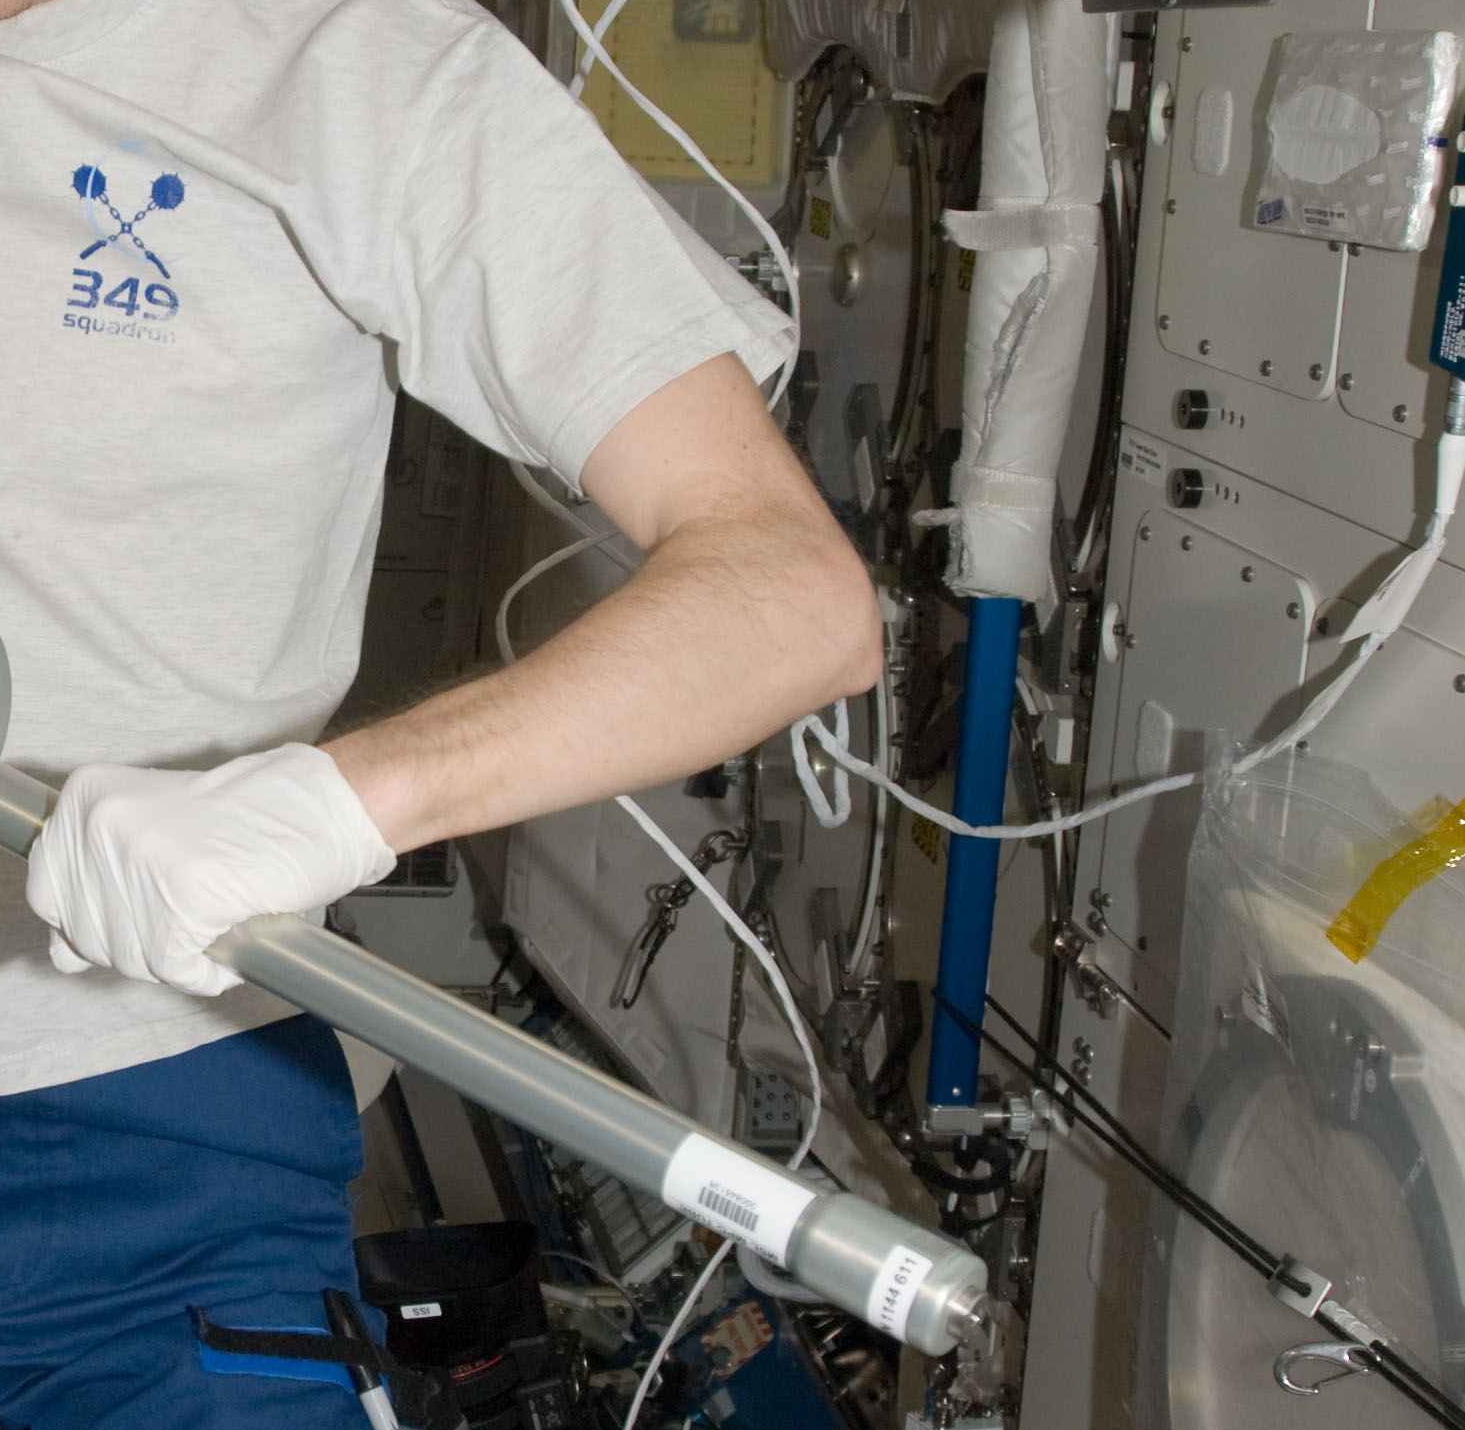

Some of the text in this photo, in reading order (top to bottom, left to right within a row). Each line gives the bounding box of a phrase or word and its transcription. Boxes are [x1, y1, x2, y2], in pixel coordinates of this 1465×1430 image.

[66, 267, 181, 323] 349
[62, 310, 178, 346] squadron
[412, 1307, 430, 1316] ISS
[880, 1287, 902, 1322] 1144
[894, 1256, 918, 1285] 611
